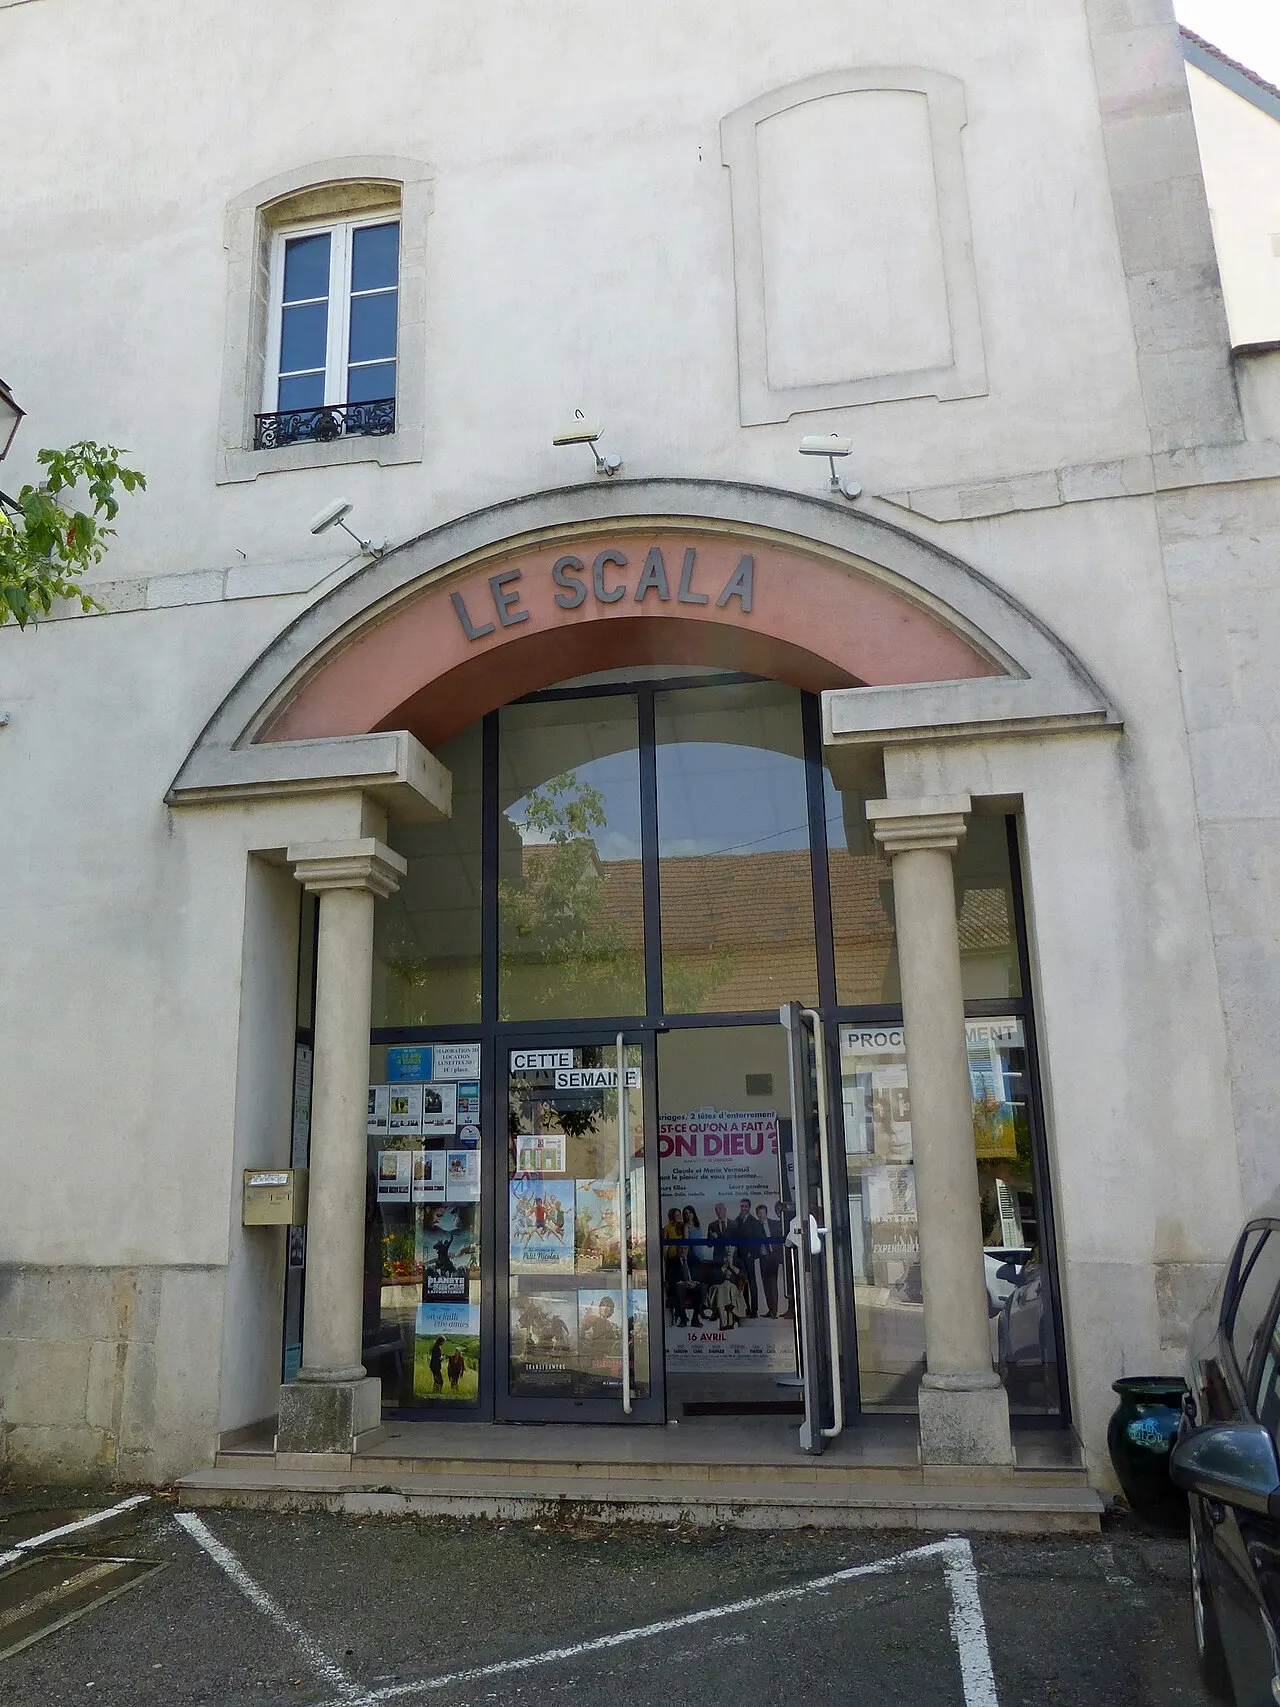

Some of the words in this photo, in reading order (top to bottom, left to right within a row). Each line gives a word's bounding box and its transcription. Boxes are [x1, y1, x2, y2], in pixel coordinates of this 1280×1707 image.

[450, 568, 530, 641] LE
[552, 546, 755, 613] SCALA
[848, 1032, 906, 1048] PROC
[966, 1026, 1014, 1041] MENT
[514, 1053, 569, 1068] CETTE
[719, 1111, 775, 1119] d'enterrement
[659, 1123, 686, 1133] ST-CE
[689, 1121, 728, 1133] QU'ON
[730, 1122, 739, 1131] A
[741, 1121, 763, 1131] FAIT
[659, 1134, 697, 1158] ON
[703, 1132, 764, 1156] DIEU
[874, 1244, 920, 1253] EXPENDABLE
[688, 1333, 697, 1341] 16
[700, 1333, 726, 1341] AVRIL
